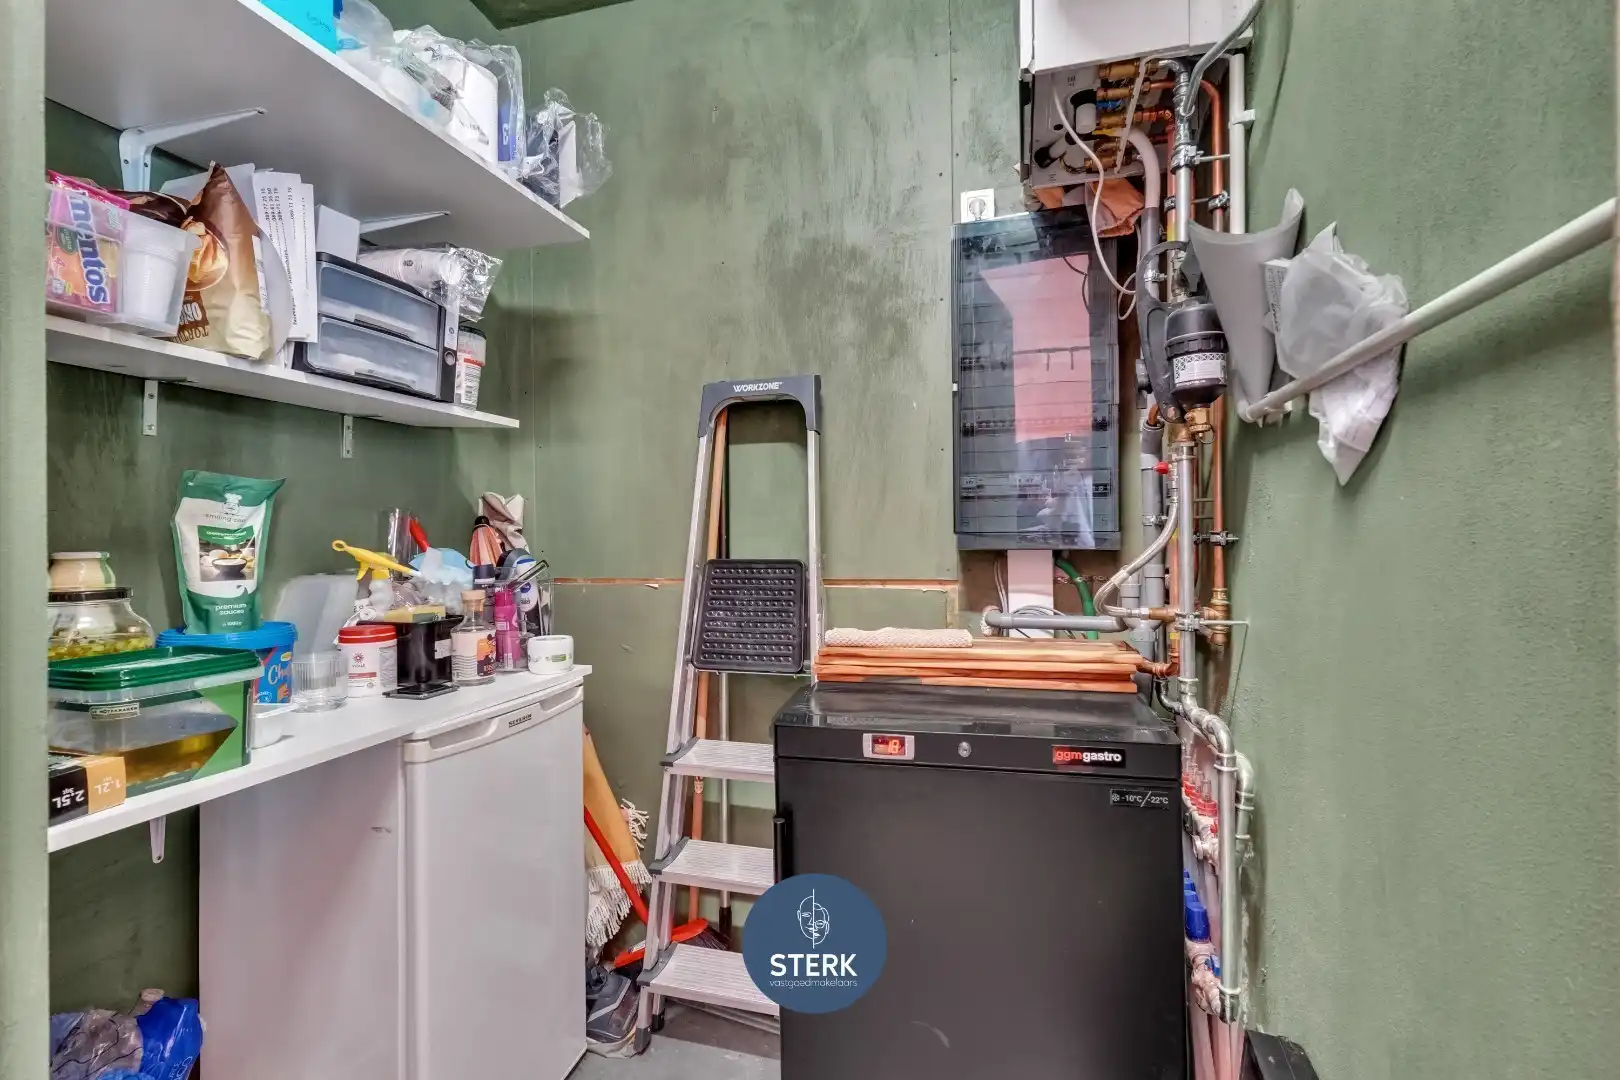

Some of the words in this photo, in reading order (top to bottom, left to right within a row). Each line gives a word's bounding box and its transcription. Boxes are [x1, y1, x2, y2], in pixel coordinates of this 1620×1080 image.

[66, 190, 110, 304] mentos
[215, 603, 247, 611] premium
[1056, 750, 1122, 762] ggmgastro
[94, 778, 122, 795] 1.2L
[51, 788, 85, 809] 2.5L
